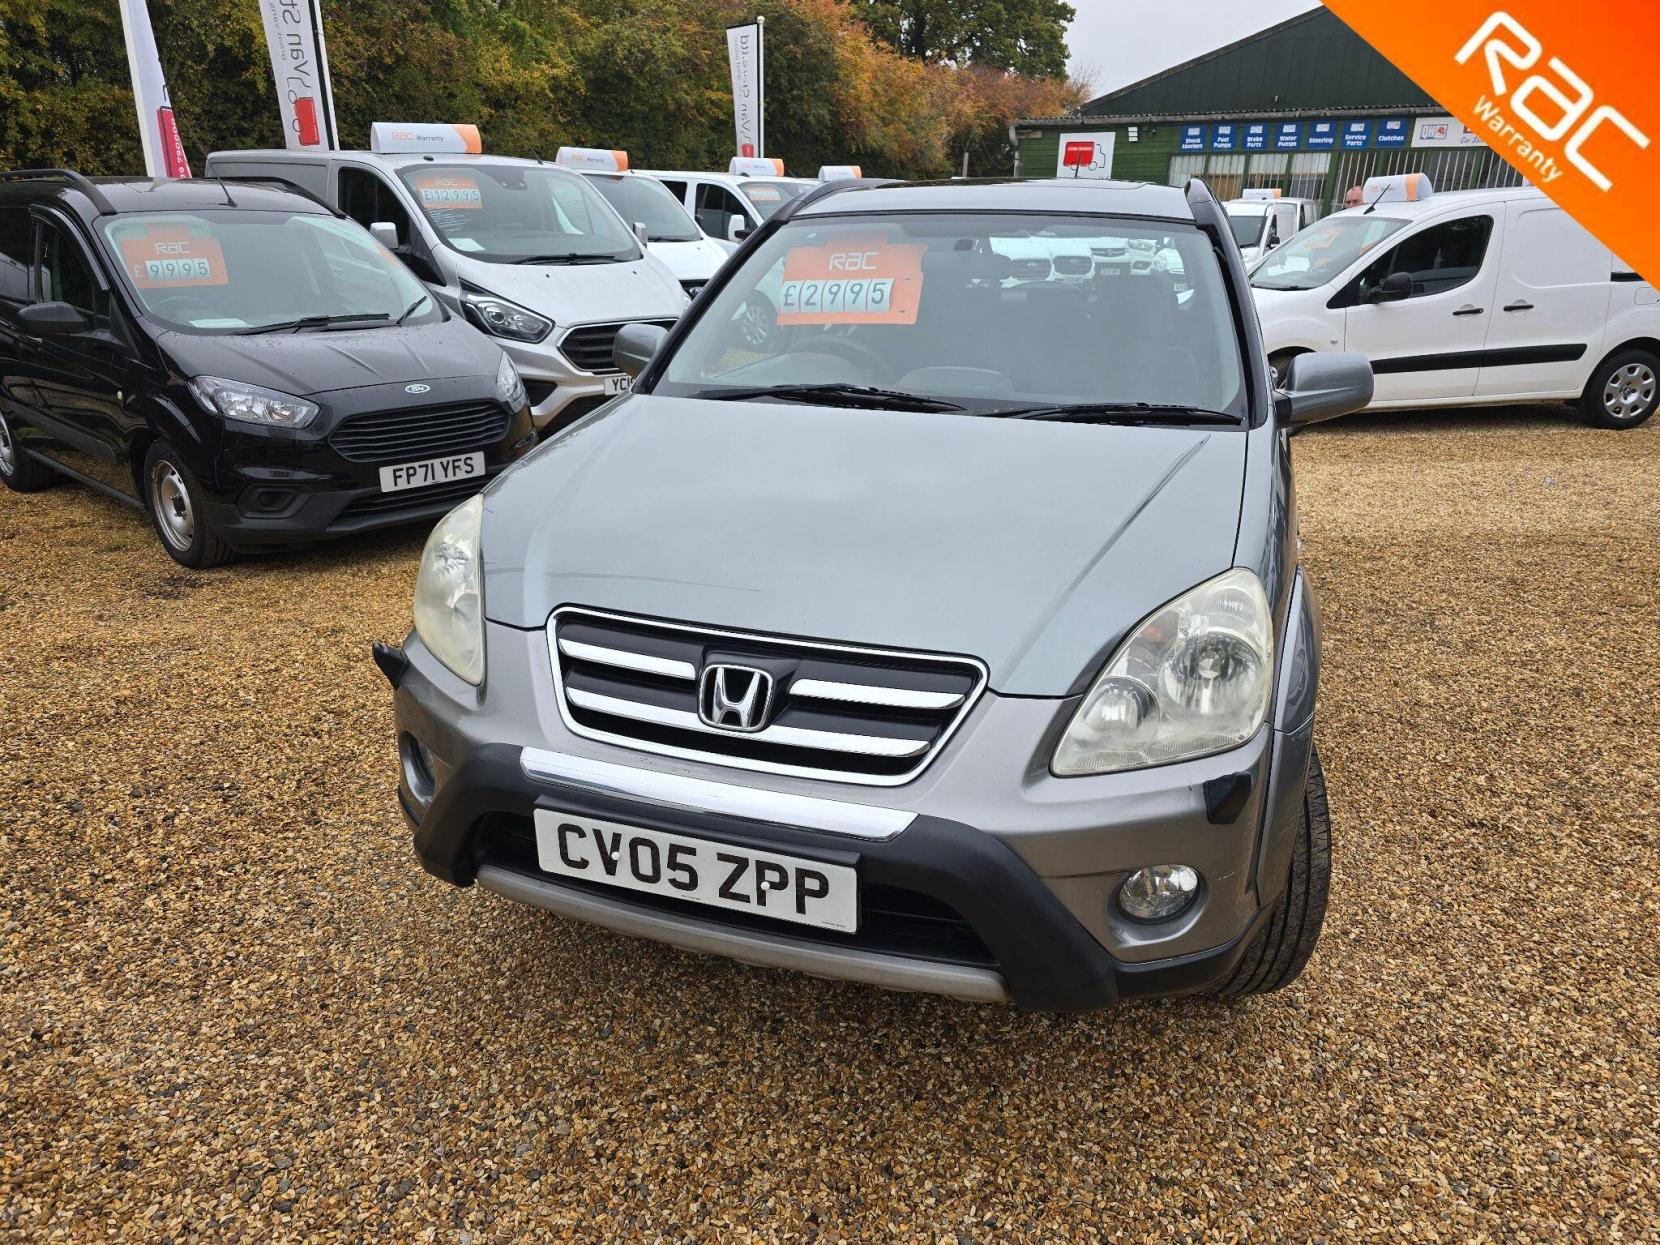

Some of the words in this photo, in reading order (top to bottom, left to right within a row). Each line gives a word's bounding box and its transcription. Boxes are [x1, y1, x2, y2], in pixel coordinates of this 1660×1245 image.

[783, 282, 887, 306] £2995
[393, 462, 436, 487] FP71
[440, 457, 475, 480] YFS
[557, 823, 699, 892] CV05
[716, 852, 830, 915] ZPP
